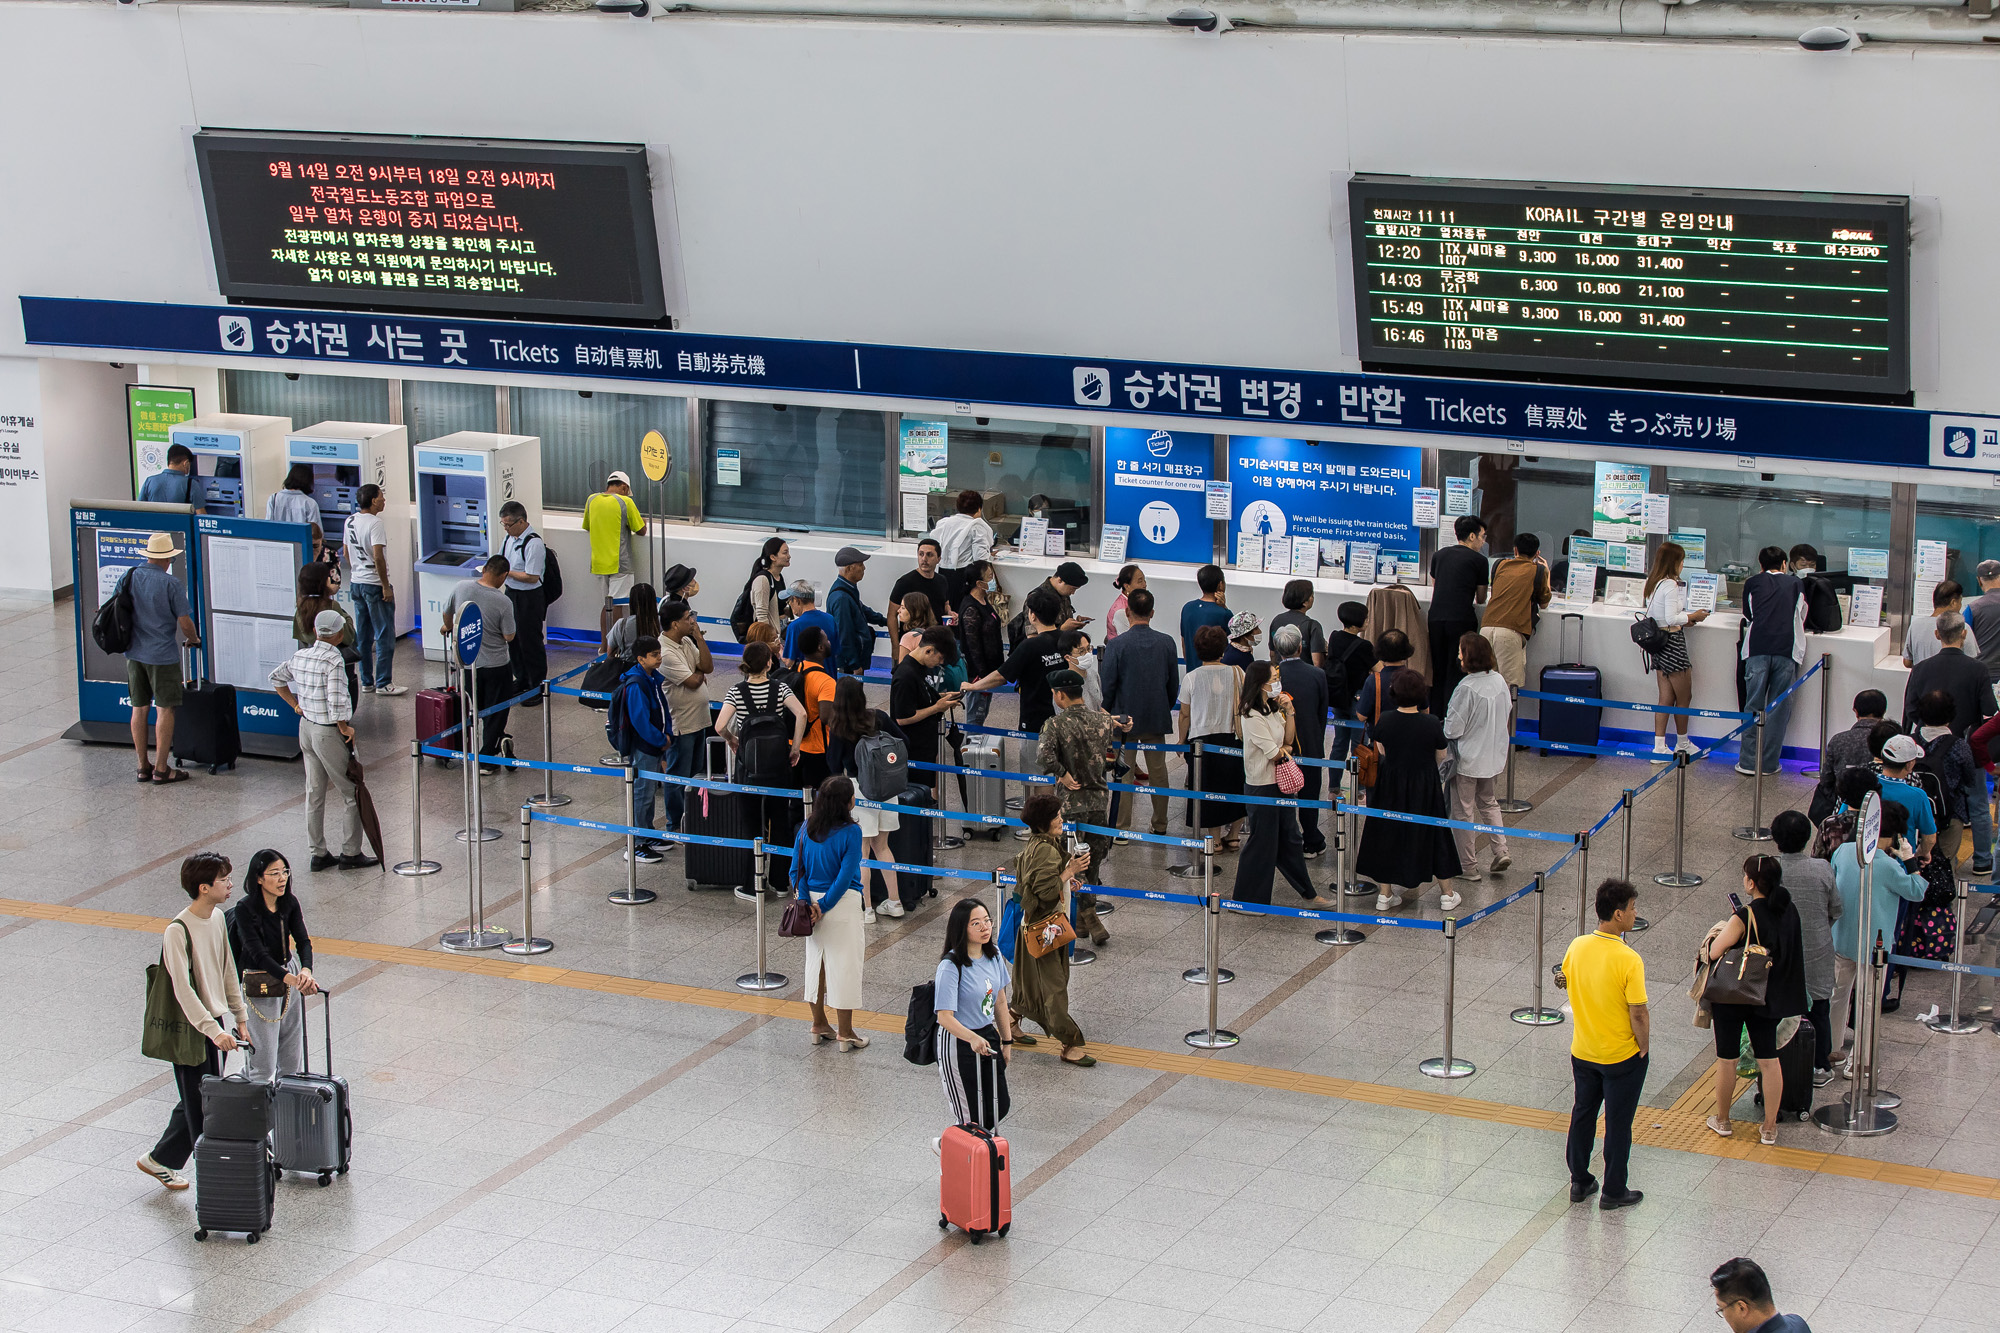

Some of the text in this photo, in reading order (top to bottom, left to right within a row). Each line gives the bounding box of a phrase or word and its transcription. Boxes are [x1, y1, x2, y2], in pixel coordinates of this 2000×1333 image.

[269, 162, 555, 190] 9월 14일 오전 9시부터 18일 오전 9시까지
[310, 186, 495, 209] 전국철도노동조합 파업으로
[289, 206, 523, 233] 일부 열차 운행이 중지 되었습니다.
[1373, 210, 1412, 221] 현재시간
[1526, 207, 1733, 231] KORAIL 구간별 운임안내
[284, 229, 536, 254] 전광판에서 열차운행 상황을 확인해 주시고
[1375, 224, 1879, 257] 출발시간 열차종류 천안 대전 동대구 익산 목포 여수EXPO
[1832, 230, 1873, 241] KORAIL
[1378, 245, 1421, 259] 12:20
[1440, 243, 1506, 258] ITX 새마을
[272, 249, 557, 276] 자세한 사항은 역 직원에게 문의하시기 바랍니다.
[1440, 254, 1467, 266] 1007
[1519, 251, 1683, 270] 9,300 16,000 31,400
[308, 268, 524, 292] 열차 이용에 불편을 드려 죄송합니다.
[1380, 272, 1421, 288] 14:03
[1441, 271, 1479, 284] 무궁화
[1441, 282, 1467, 294] 1211
[1521, 279, 1558, 292] 6,300
[1639, 285, 1684, 298] 21,100
[1382, 300, 1423, 315] 15:49
[1443, 299, 1509, 313] ITX 새마을
[1442, 310, 1468, 322] 1011
[1522, 307, 1685, 327] 9,300 16,000 31,400
[1383, 328, 1425, 343] 16:46
[1445, 327, 1498, 341] ITX 마음
[266, 320, 766, 376] 승차권 사는 곳 Tickets 自动售票机 自動券売機
[1444, 339, 1472, 350] 1103
[1124, 370, 1737, 441] 승차권 변경 반환 Tickets 售票处 きっぷ売り場
[1117, 460, 1127, 470] 한
[1142, 462, 1161, 473] 서기
[1165, 464, 1203, 476] 매표창구
[1239, 457, 1411, 481] 대기순서대로 먼저 발매를 도와드리니
[1139, 478, 1163, 486] counter
[1252, 475, 1397, 496] 이점 양해하여 주시기 바랍니다.
[75, 511, 96, 520] 알림판
[1304, 515, 1317, 523] will
[1318, 516, 1327, 524] be
[1328, 517, 1352, 527] issuing
[1354, 519, 1365, 527] the
[1366, 520, 1383, 529] train
[1385, 522, 1408, 530] tickets
[198, 519, 218, 528] 알림판
[1293, 525, 1406, 541] First-come First-served basis,
[582, 691, 603, 699] KORAIL
[1565, 696, 1585, 704] KORAIL
[243, 705, 279, 717] KORAIL
[962, 768, 982, 776] KORAIL
[859, 800, 882, 809] KORAIL
[1276, 799, 1298, 807] KORAIL
[920, 808, 944, 817] KORAIL
[982, 816, 1006, 824] KORAIL
[1119, 831, 1143, 840] KORAIL
[1473, 824, 1492, 833] KORAIL
[1222, 902, 1243, 910] KORAIL
[1376, 918, 1398, 926] KORAIL
[1942, 963, 1971, 973] KORAIL
[149, 1016, 190, 1034] ARKET
